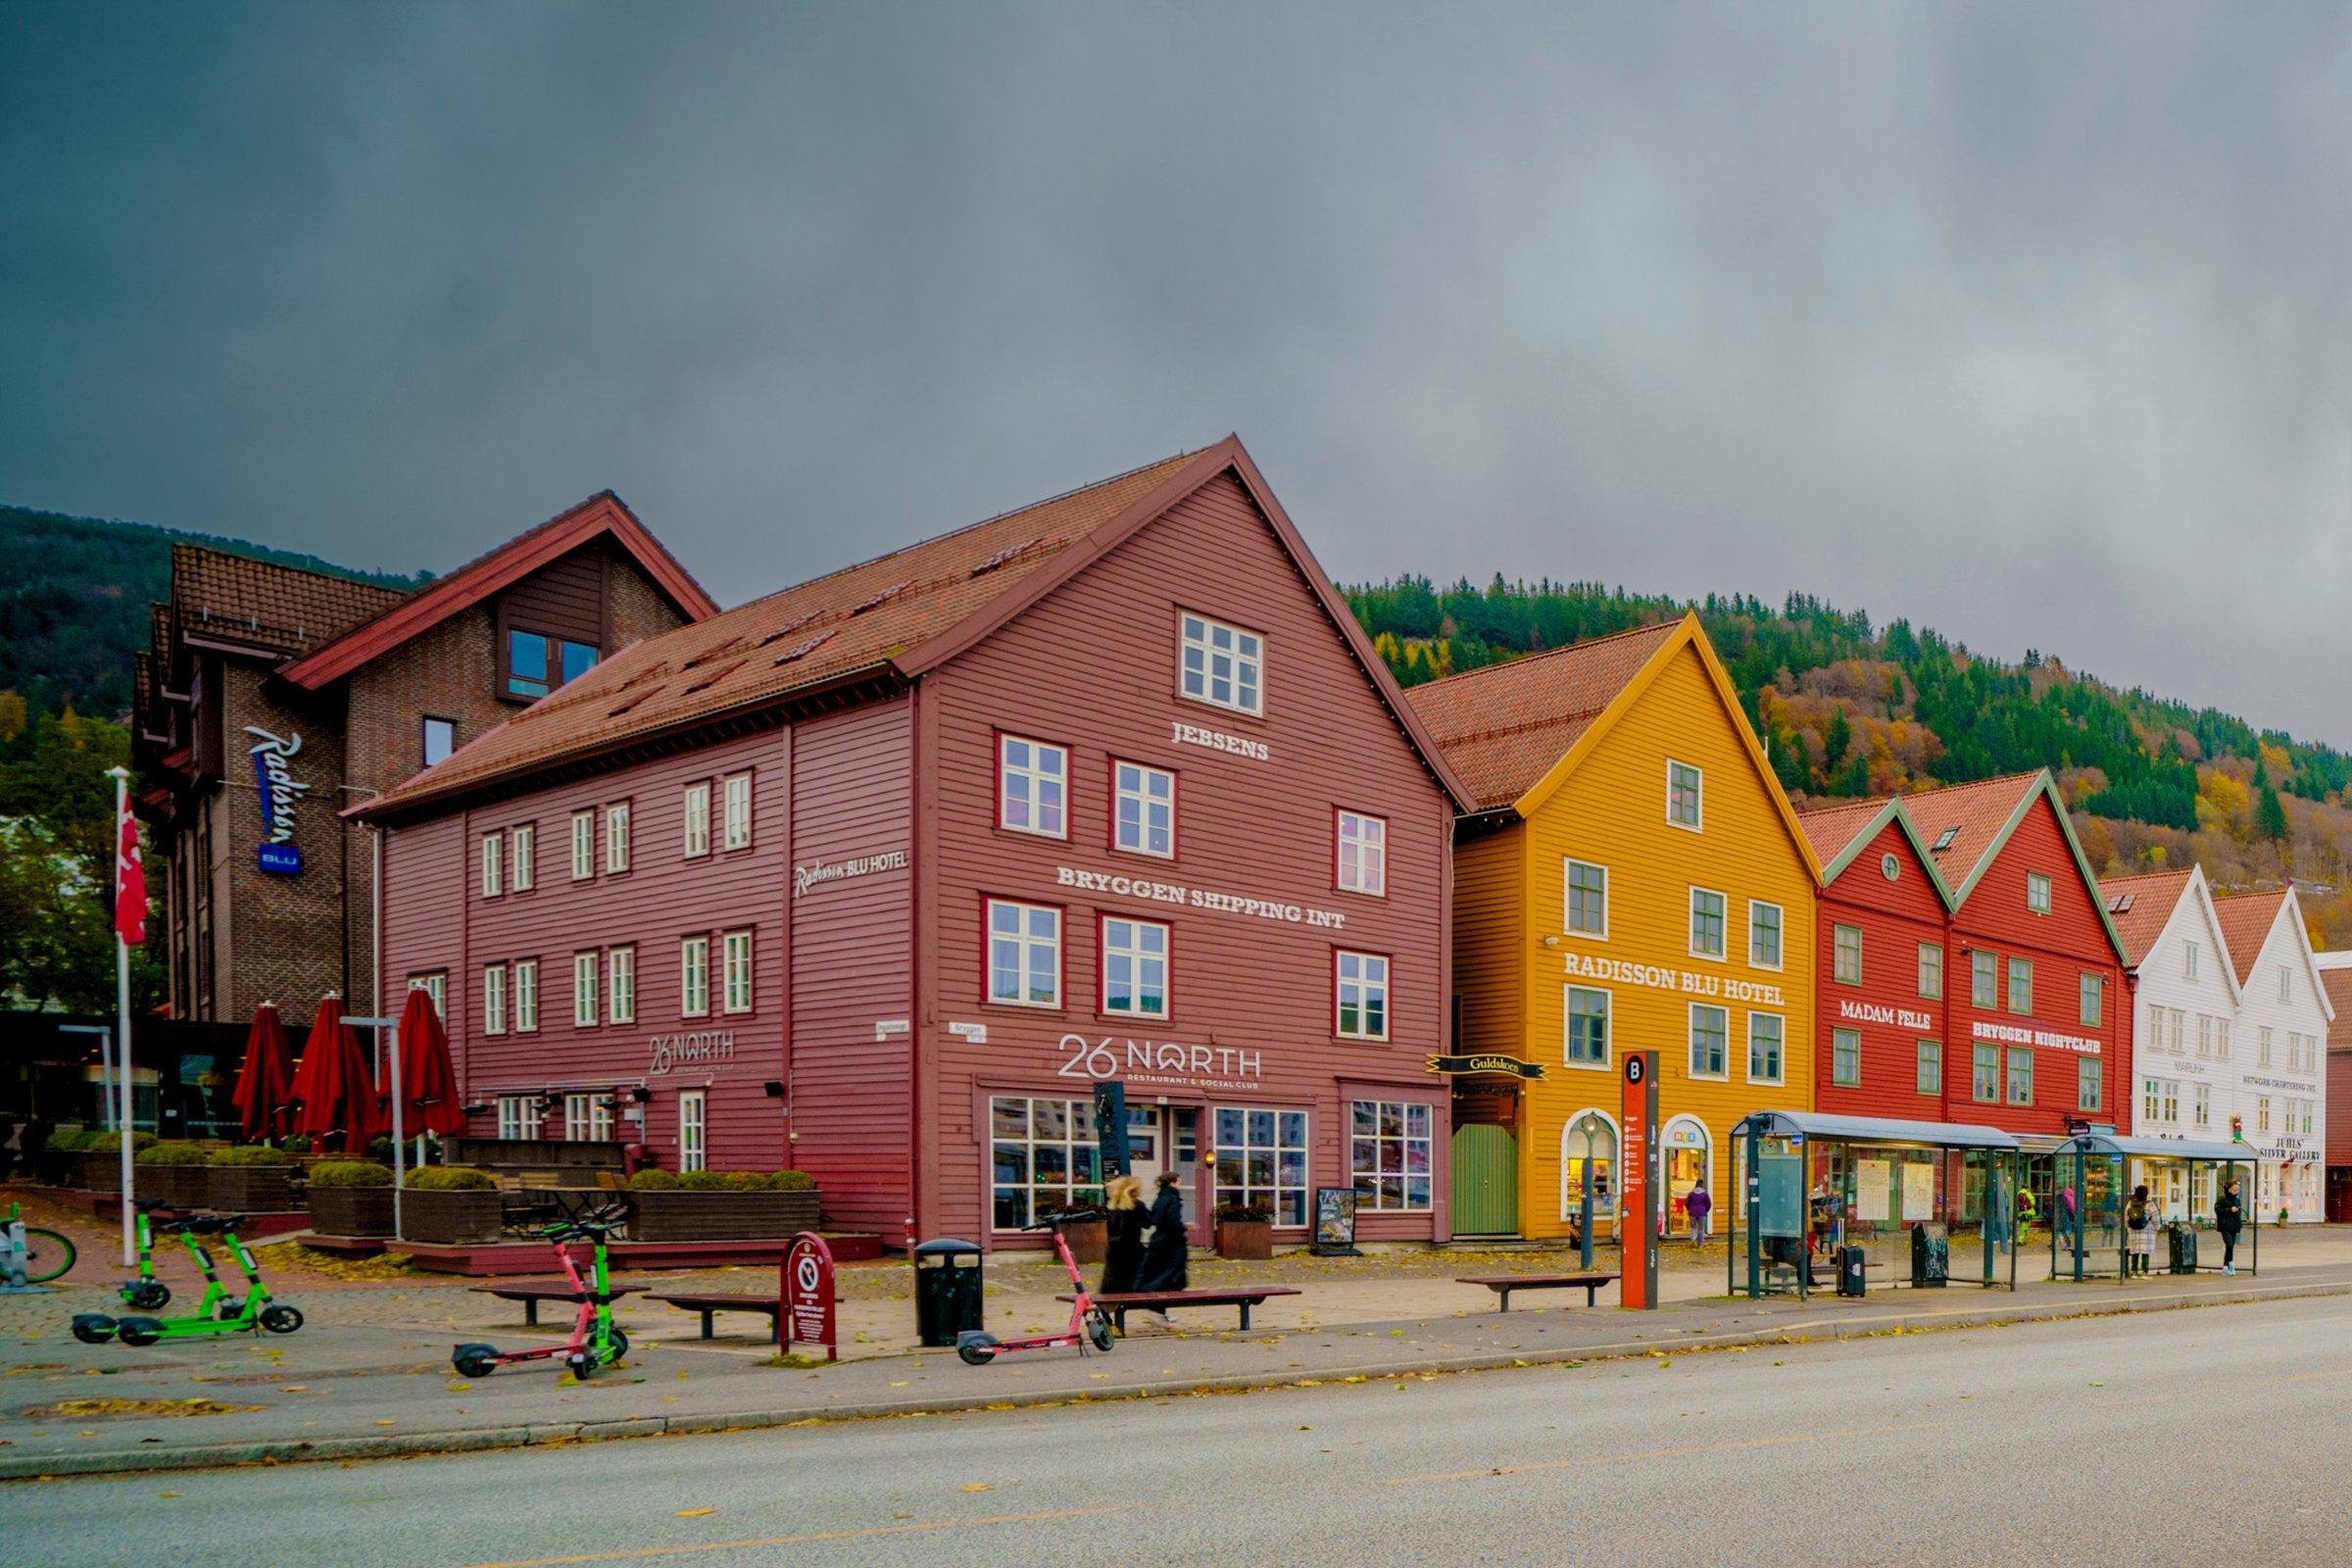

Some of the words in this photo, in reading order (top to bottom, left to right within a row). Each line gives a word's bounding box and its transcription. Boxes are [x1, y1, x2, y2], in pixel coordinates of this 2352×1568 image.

[1171, 721, 1269, 760] JEBSENS
[243, 726, 311, 844] Radisson
[262, 854, 297, 865] BLU
[795, 858, 844, 900] Radisson
[847, 858, 868, 876] BLU
[870, 851, 908, 871] HOTEL
[1056, 866, 1186, 905] BRYGGEN
[1191, 890, 1301, 922] SHIPPING
[1306, 907, 1346, 929] INT
[1564, 953, 1677, 990] RADISSON
[1681, 971, 1719, 996] BLU
[1724, 978, 1786, 1005] HOTEL
[1840, 1000, 1894, 1024] MADAM
[1897, 1009, 1931, 1030] FELLE
[649, 1034, 672, 1075] 26
[673, 1030, 734, 1061] NORTH
[1057, 1034, 1117, 1079] 26
[1127, 1040, 1260, 1078] NORTH
[1972, 1021, 2032, 1044] BRYGGEN
[2034, 1031, 2101, 1054] NIGHTCLUB
[1127, 1073, 1187, 1085] RESTAURANT
[1200, 1079, 1234, 1088] SOCIAL
[1630, 1061, 1641, 1079] B
[2260, 1147, 2286, 1158] SILVER
